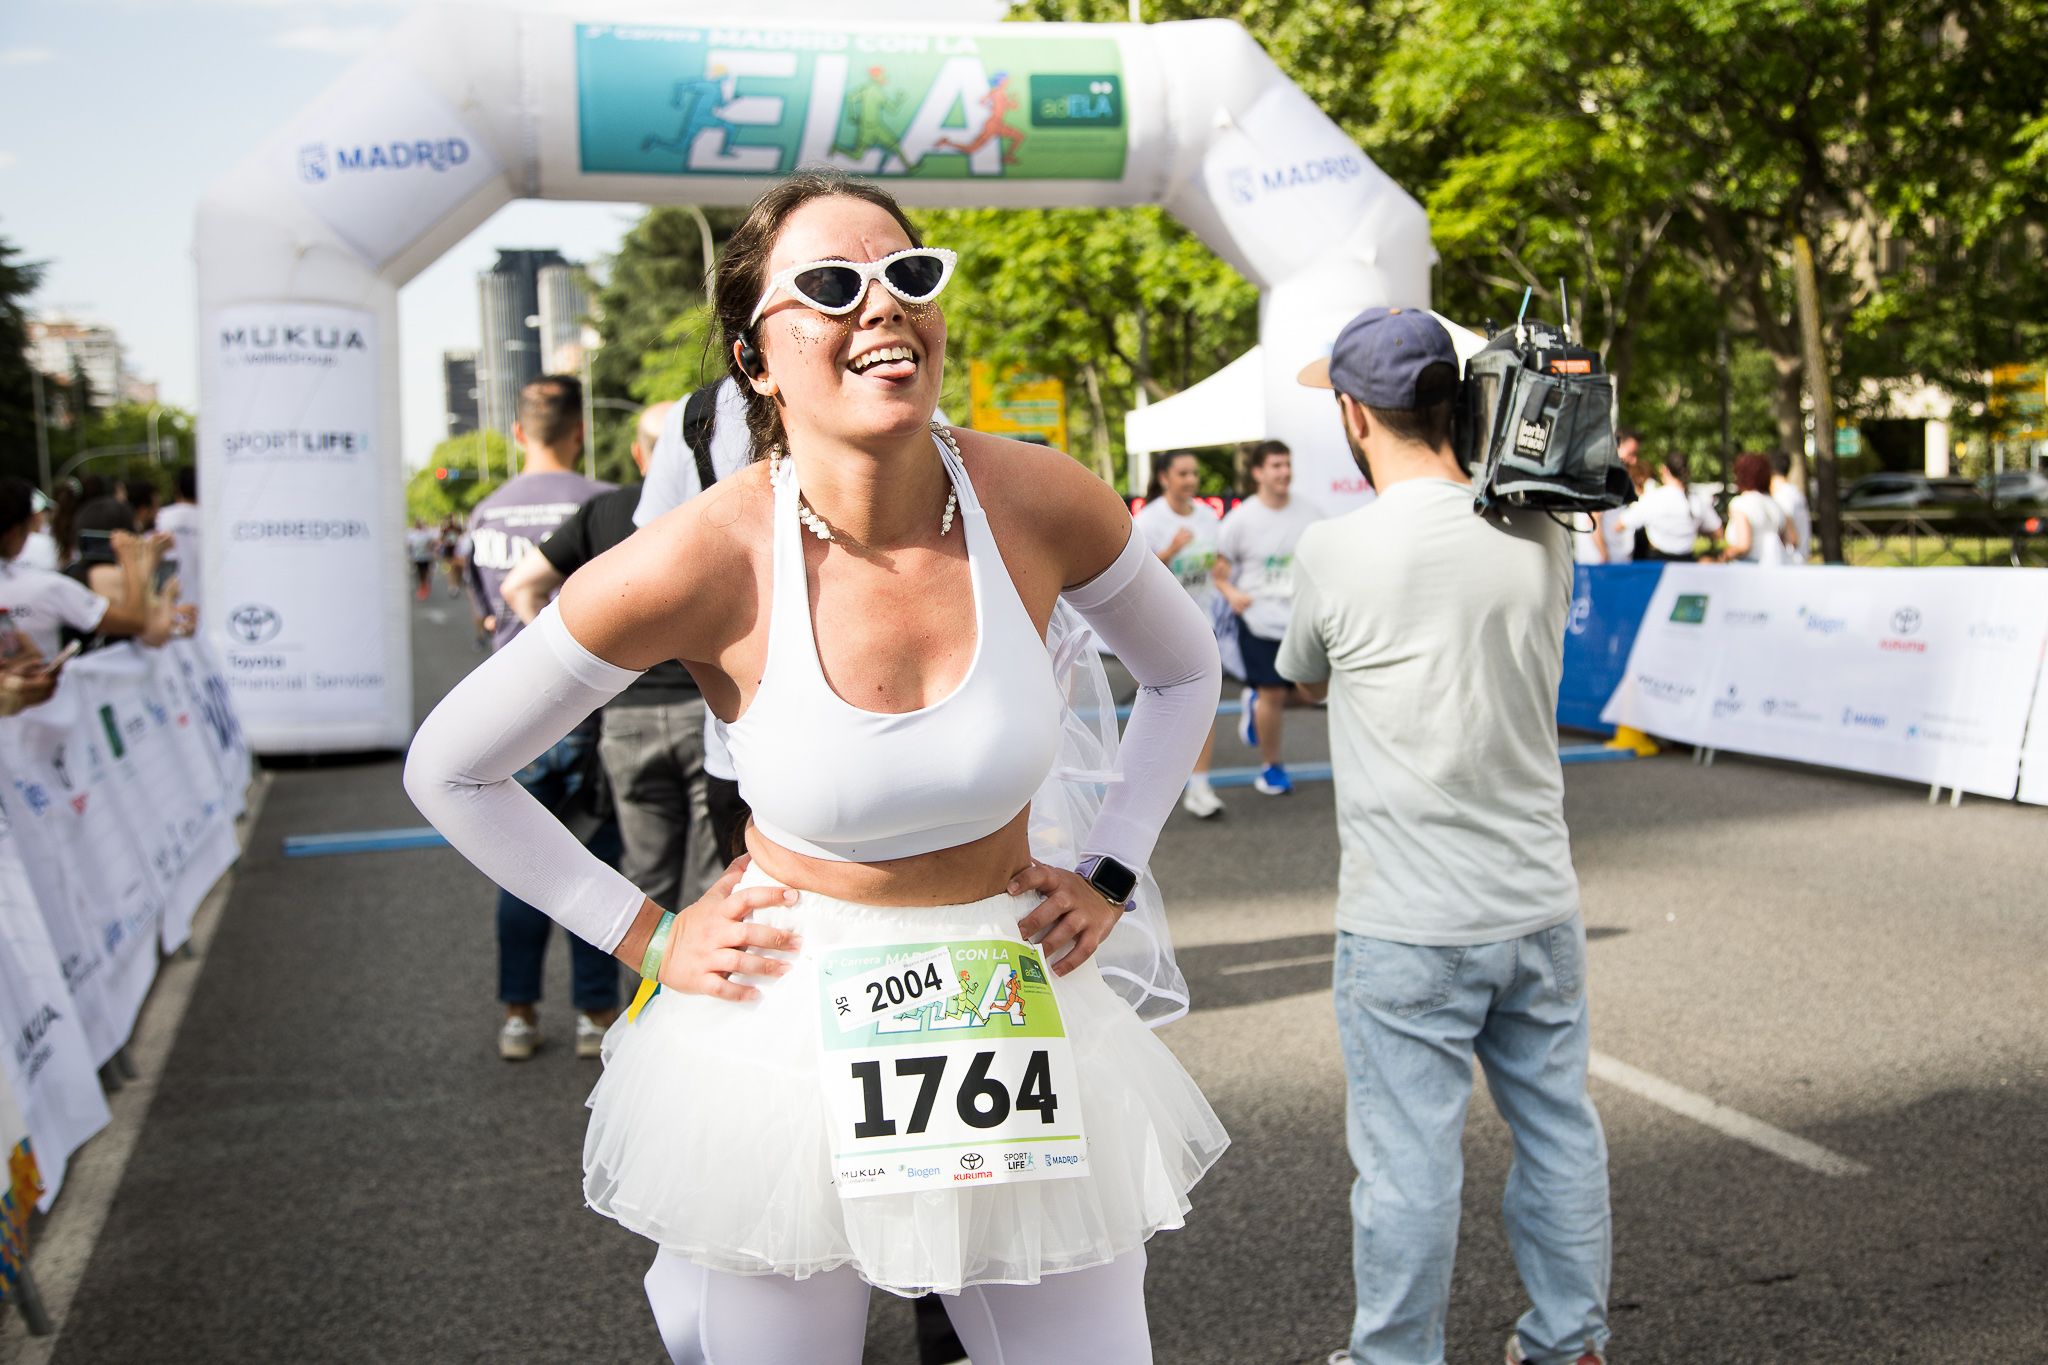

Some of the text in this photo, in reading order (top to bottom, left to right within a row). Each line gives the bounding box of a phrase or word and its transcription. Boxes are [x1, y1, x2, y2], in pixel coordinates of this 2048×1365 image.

[706, 28, 849, 53] MADRID
[855, 33, 930, 56] CON
[936, 35, 981, 56] LA
[687, 50, 1001, 176] ELA
[336, 136, 471, 173] MADRID
[1261, 155, 1361, 190] MADRID
[219, 324, 368, 351] MUKUA
[230, 655, 286, 672] Toyota
[955, 948, 988, 961] CON
[992, 948, 1009, 960] LA
[866, 962, 943, 1013] 2004
[835, 996, 851, 1016] 5K
[851, 1050, 1058, 1139] 1764
[1003, 1152, 1028, 1162] SPORT
[1008, 1160, 1026, 1170] LIFE
[1052, 1155, 1079, 1165] MADRID
[841, 1167, 886, 1179] MUKUA
[907, 1167, 941, 1178] Biogen
